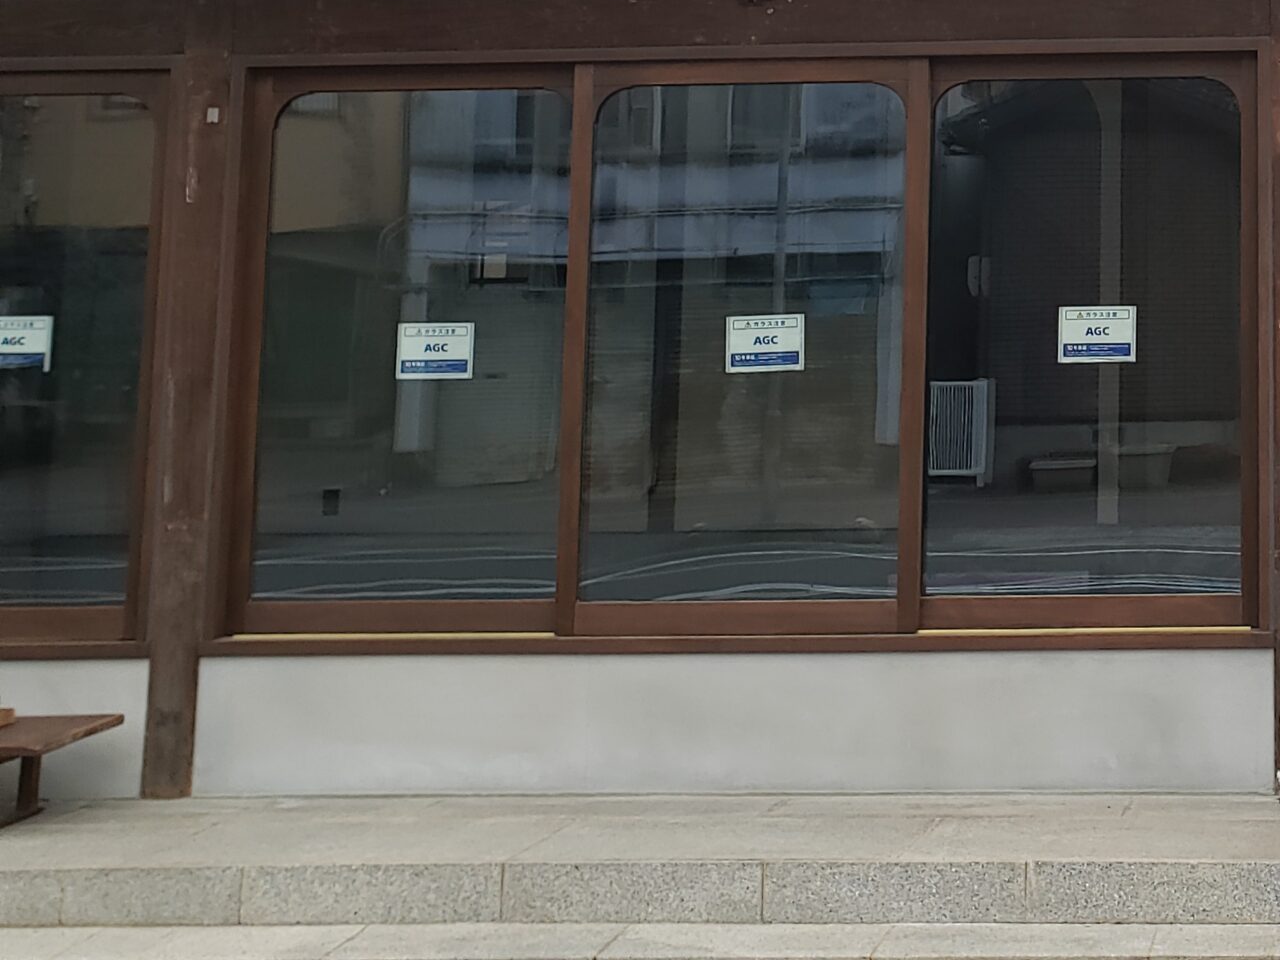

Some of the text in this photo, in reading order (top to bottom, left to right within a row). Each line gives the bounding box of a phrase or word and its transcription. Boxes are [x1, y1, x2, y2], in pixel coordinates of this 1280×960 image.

[1085, 326, 1110, 336] AGC
[1, 336, 26, 346] AGC
[752, 335, 778, 345] AGC
[424, 343, 448, 353] AGC
